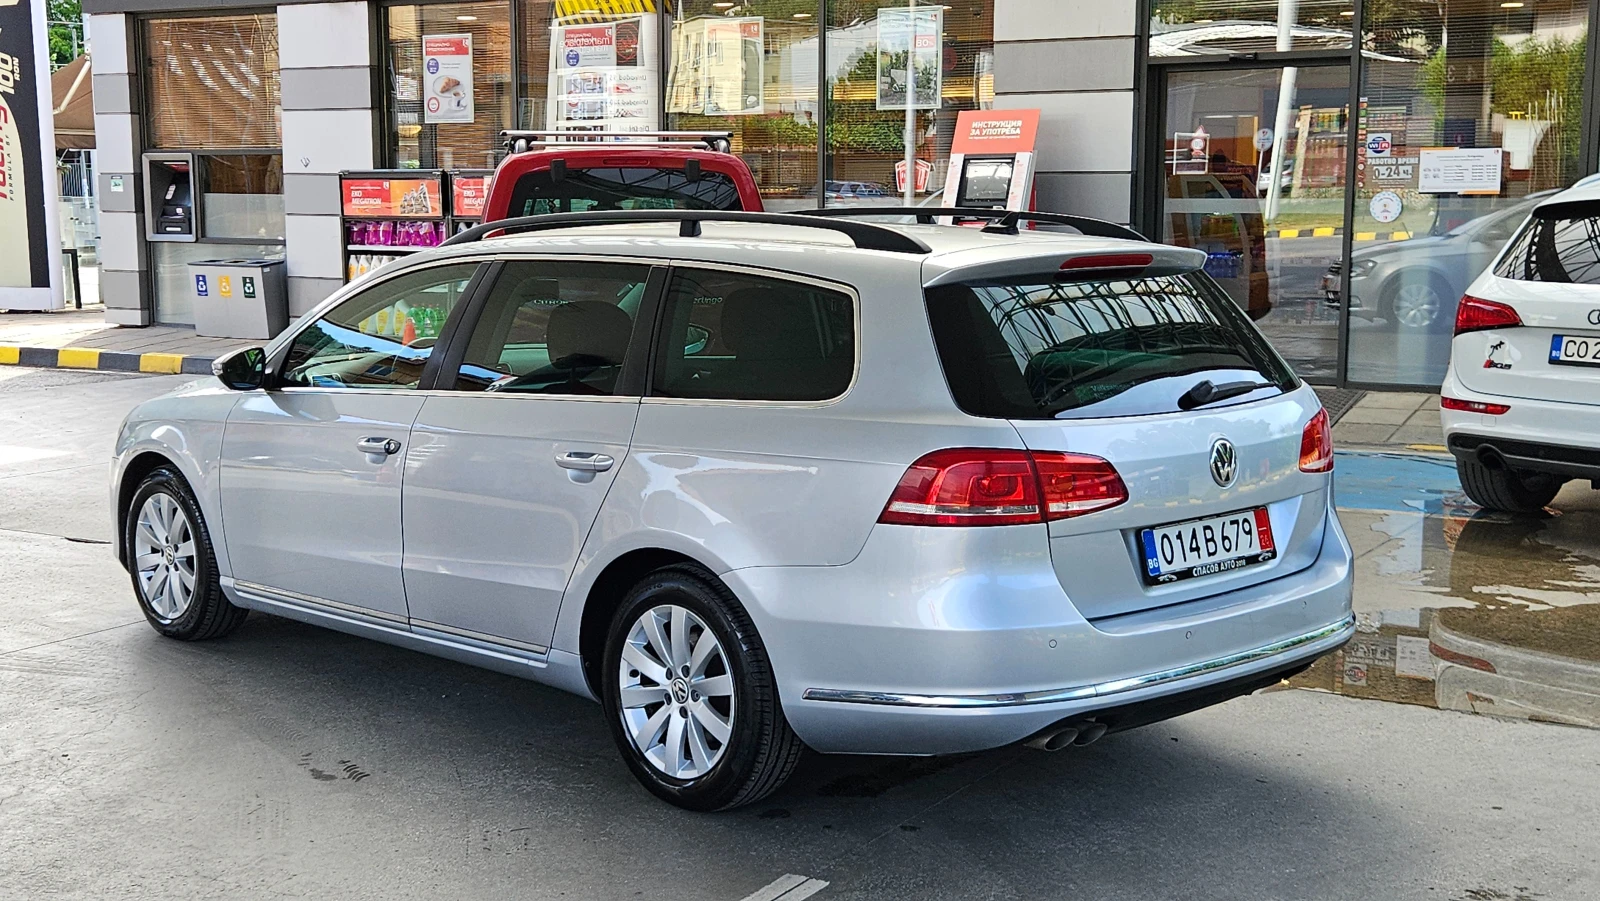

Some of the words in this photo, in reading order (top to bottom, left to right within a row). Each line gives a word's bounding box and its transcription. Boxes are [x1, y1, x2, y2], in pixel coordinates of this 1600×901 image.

[13, 57, 21, 81] RON
[971, 120, 1022, 129] ИНСТРУКЦИЯ
[969, 128, 980, 136] ЗА
[981, 126, 1021, 136] УПОТРЕБА
[1148, 558, 1159, 569] BG
[1192, 563, 1219, 577] СПАСОВ
[1220, 560, 1236, 571] АУТО
